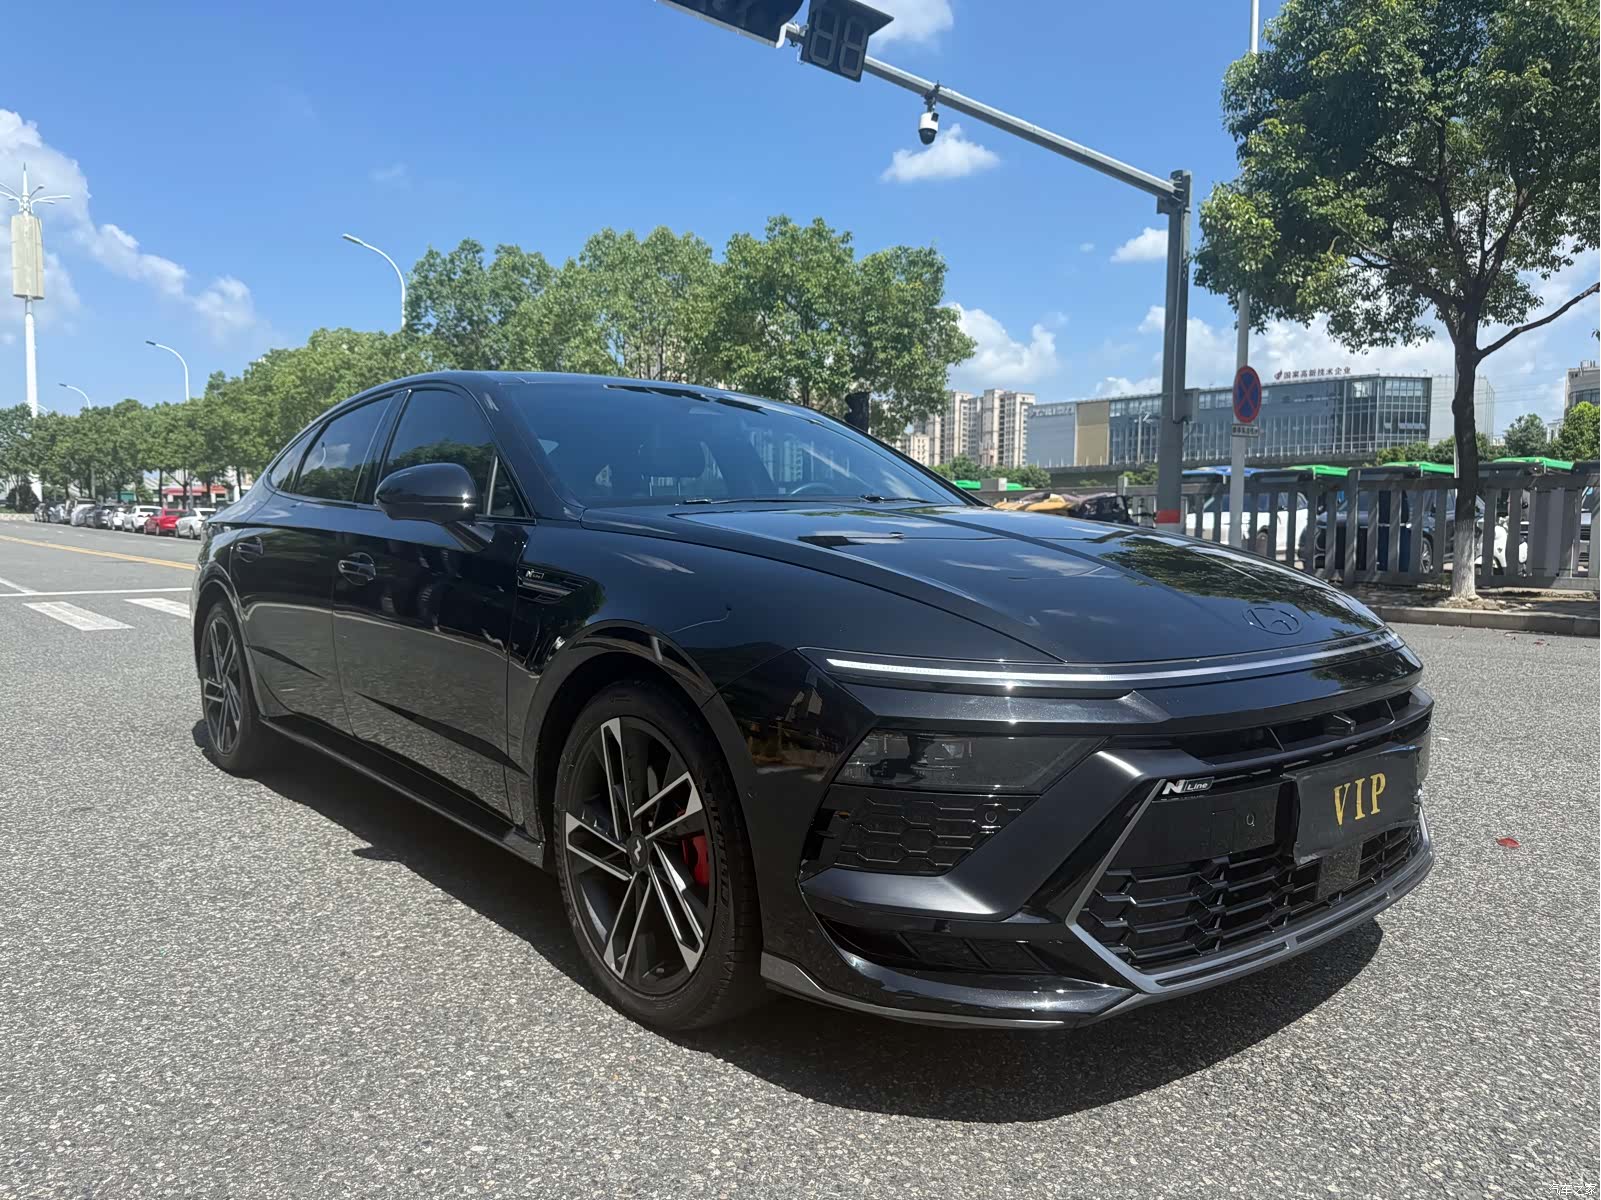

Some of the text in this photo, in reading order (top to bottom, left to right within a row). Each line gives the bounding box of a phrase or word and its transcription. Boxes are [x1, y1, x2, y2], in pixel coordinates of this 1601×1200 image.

[1283, 367, 1351, 379] 国家高新技术企业
[1162, 779, 1208, 795] N Line
[1333, 772, 1386, 826] VIP
